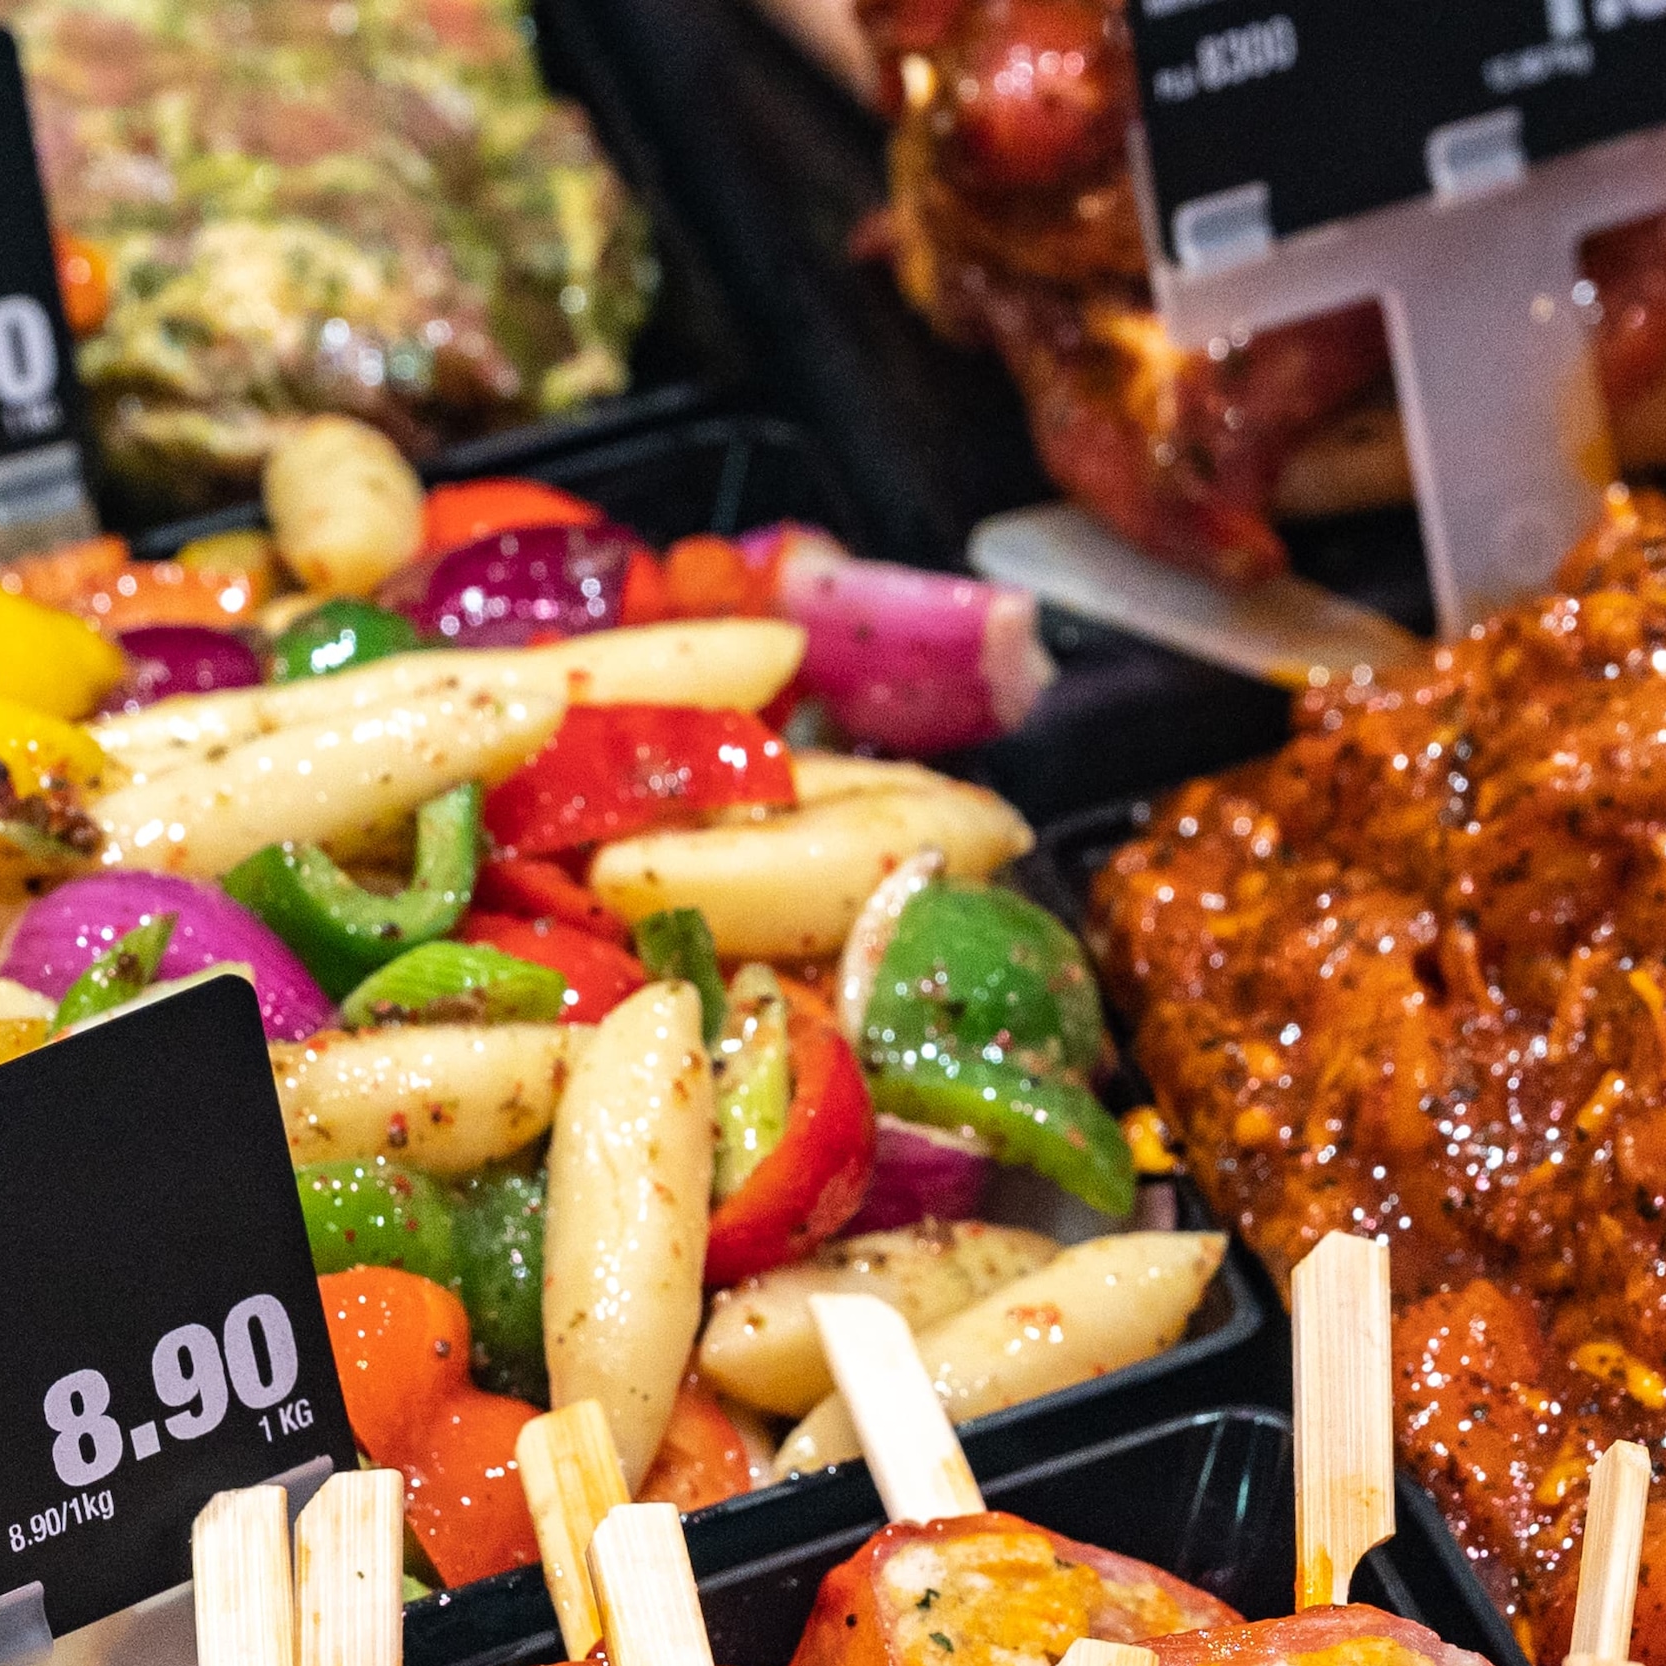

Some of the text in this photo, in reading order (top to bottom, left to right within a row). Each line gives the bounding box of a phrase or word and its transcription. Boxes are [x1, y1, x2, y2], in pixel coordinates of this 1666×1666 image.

[43, 1293, 300, 1487] 8.90
[258, 1398, 314, 1442] 1 KG
[8, 1489, 115, 1553] 8.90/1kg
